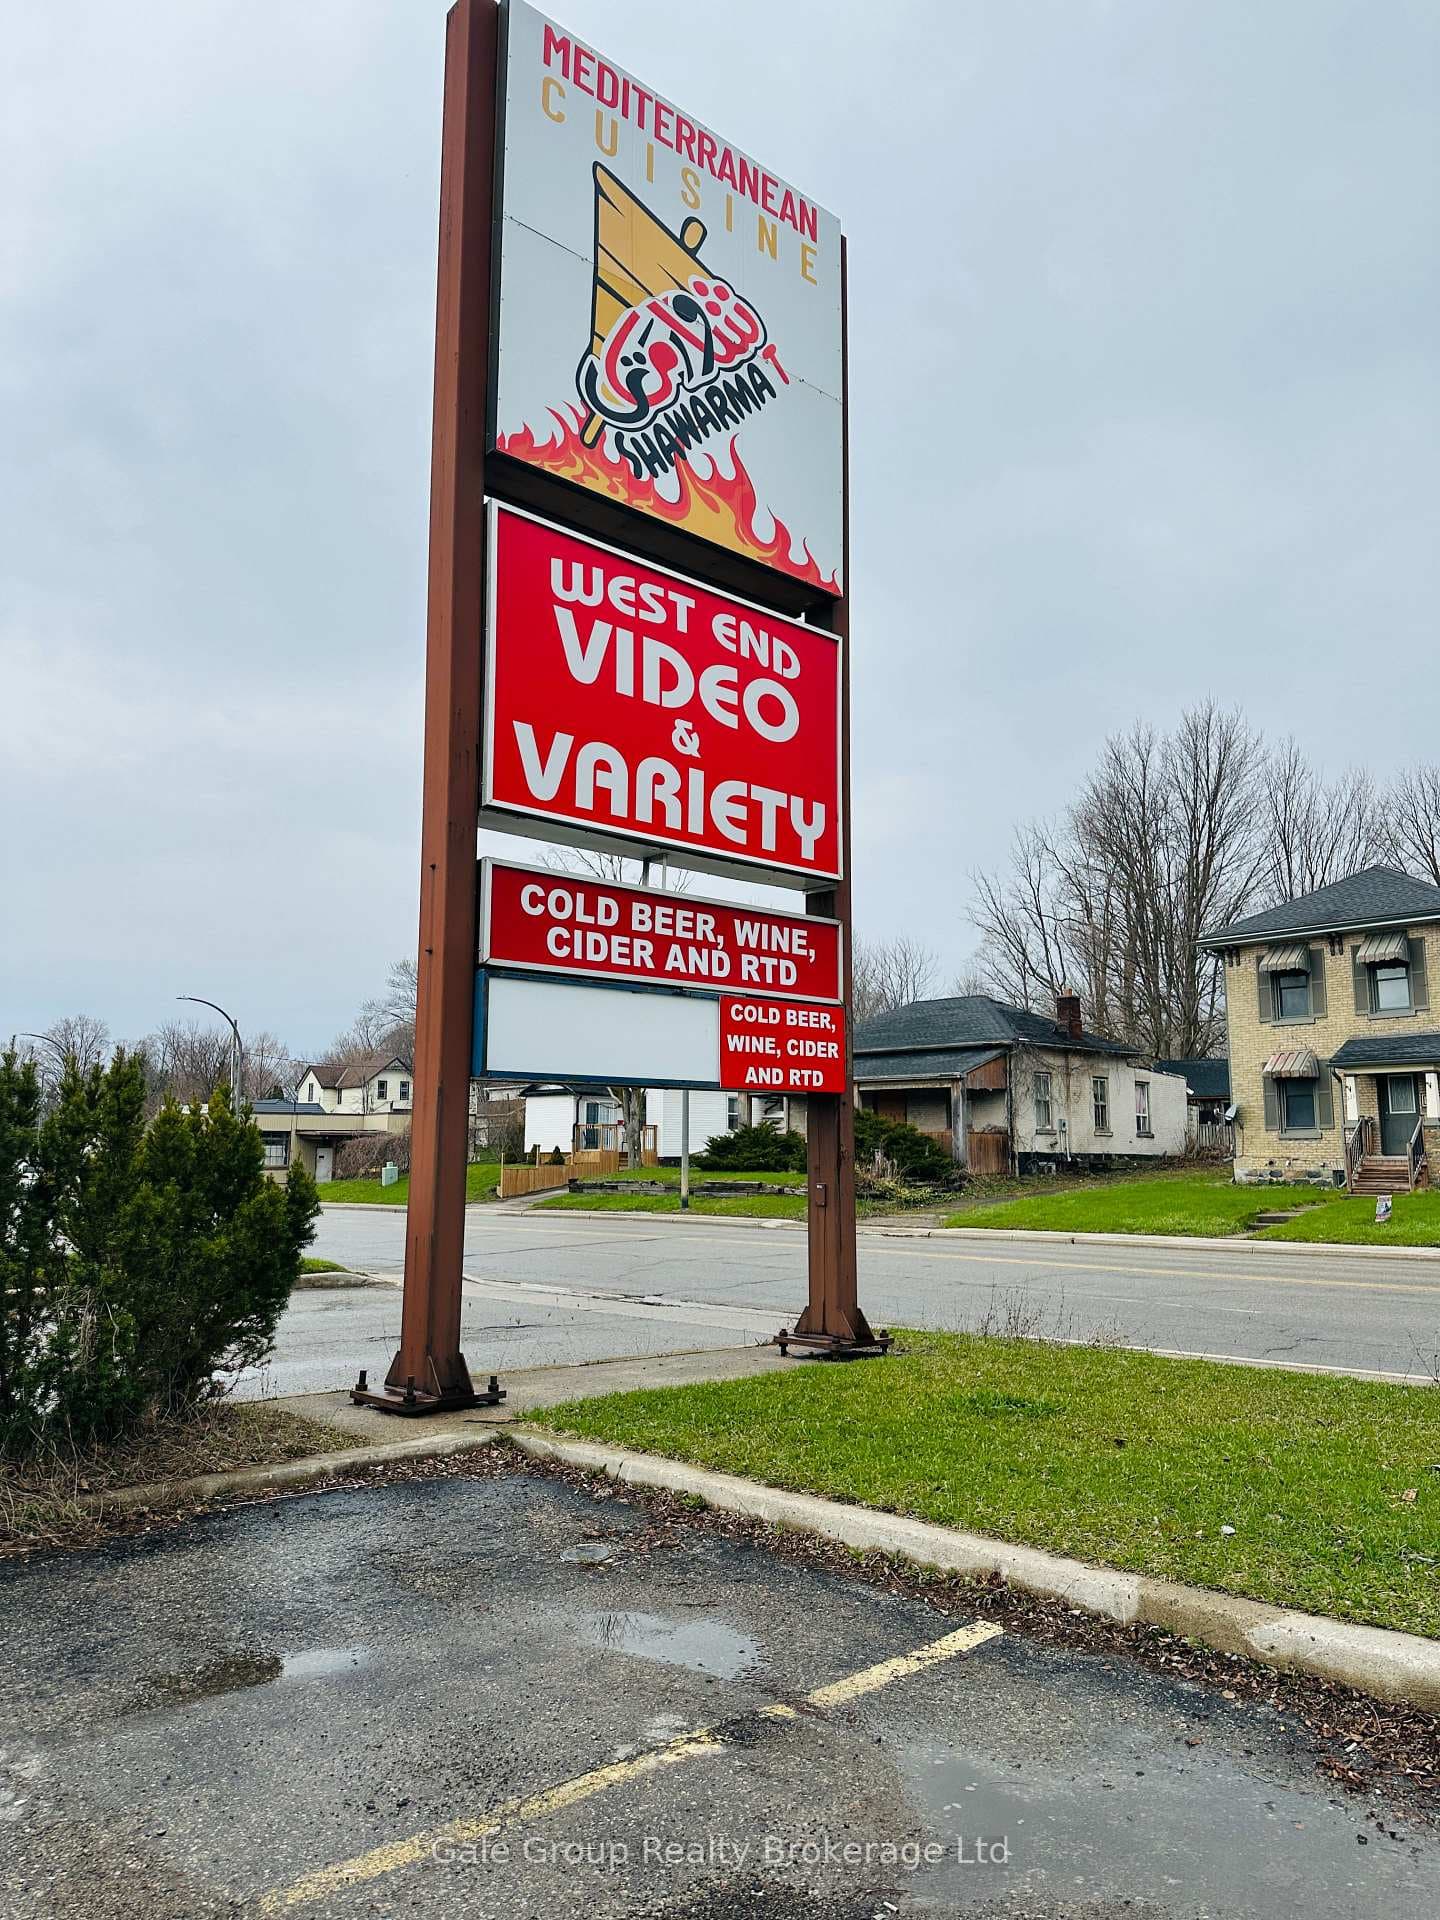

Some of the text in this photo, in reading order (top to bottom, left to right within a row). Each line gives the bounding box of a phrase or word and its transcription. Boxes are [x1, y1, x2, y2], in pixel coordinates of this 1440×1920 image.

[542, 76, 818, 286] CUISINE
[543, 24, 818, 243] MEDITERRANEAN
[614, 363, 777, 480] SHAWARMA
[551, 557, 801, 680] WEST END
[553, 604, 800, 743] VIDEO
[671, 718, 702, 759] &
[512, 720, 826, 861] VARIETY
[520, 884, 816, 964] COLD BEER, WINE,
[546, 926, 798, 987] CIDER AND RTD
[726, 1034, 839, 1059] WINE, CIDER
[730, 1003, 837, 1033] COLD BEER,
[745, 1066, 824, 1087] AND RTD
